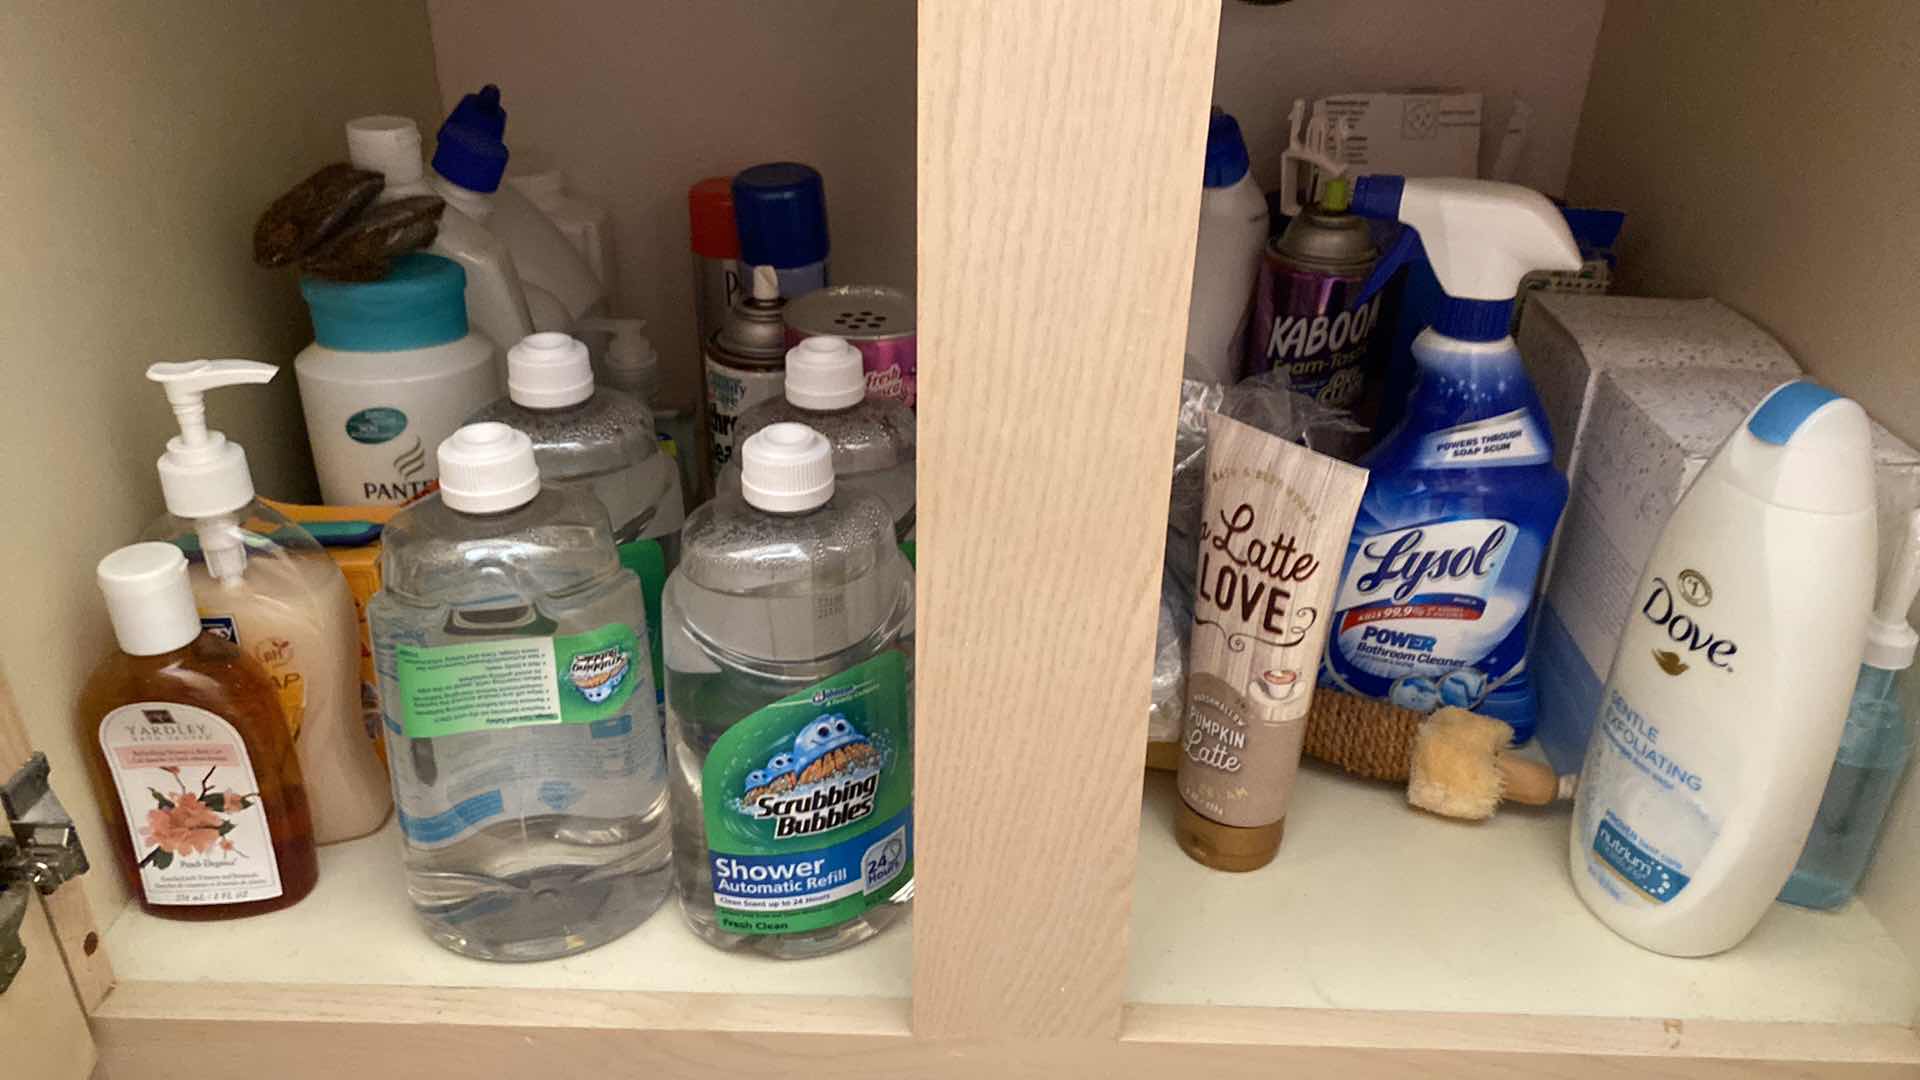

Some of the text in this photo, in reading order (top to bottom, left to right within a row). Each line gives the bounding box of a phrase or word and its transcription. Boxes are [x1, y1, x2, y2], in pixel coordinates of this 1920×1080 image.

[1436, 429, 1523, 452] POWERS THROUGH
[1453, 442, 1511, 458] SOAP SCUM
[1212, 503, 1320, 582] Latte
[1356, 524, 1506, 600] Lysol
[1200, 552, 1291, 635] LOVE
[1642, 575, 1739, 668] Dove
[1361, 625, 1437, 653] POWER
[1357, 642, 1416, 662] Bathroom
[1417, 653, 1466, 668] Cleaner
[124, 722, 207, 737] YARDLEY
[1190, 705, 1245, 749] PUMPKIN
[1185, 729, 1241, 773] Latte
[1605, 705, 1703, 791] EXFOLIATING
[757, 774, 877, 818] Scrubbing
[777, 800, 872, 838] Bubbles
[716, 858, 825, 880] Shower
[868, 855, 888, 874] 24
[719, 867, 847, 894] Automatic Refill
[768, 900, 779, 908] up
[723, 918, 788, 930] Fresh Clean
